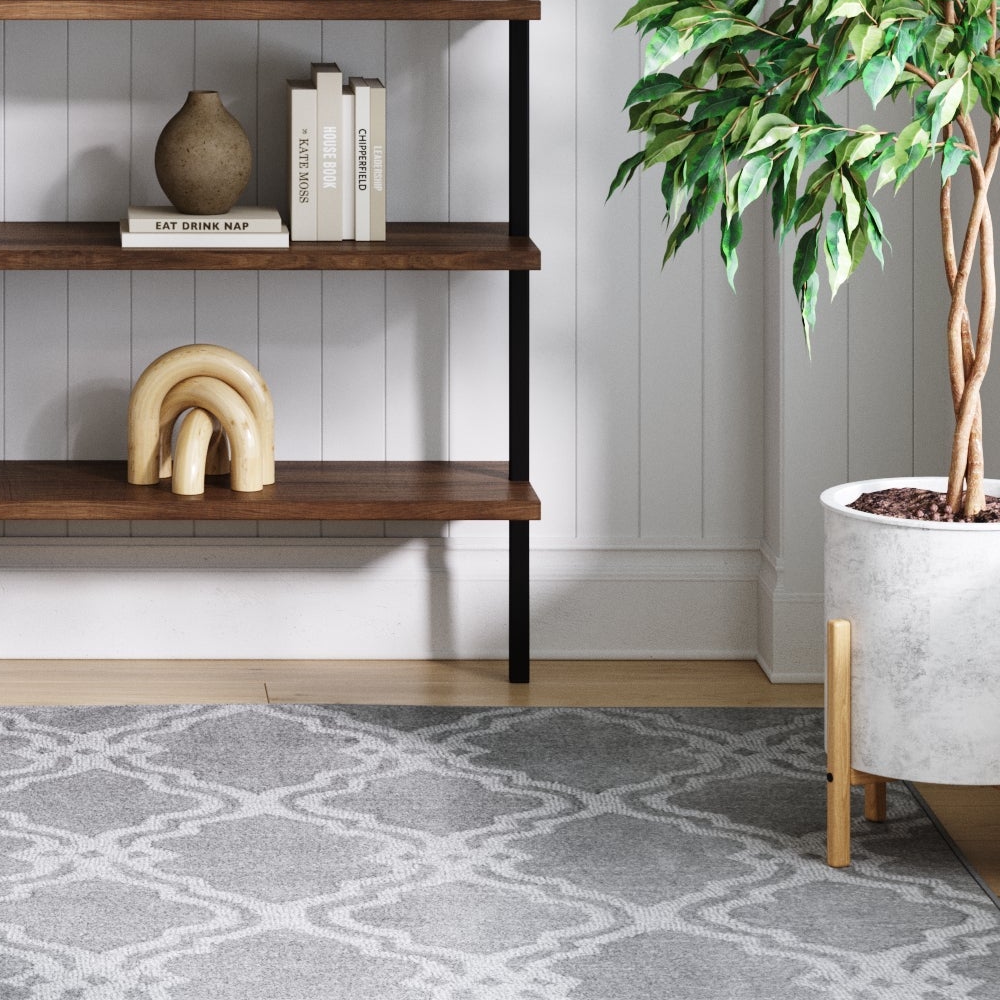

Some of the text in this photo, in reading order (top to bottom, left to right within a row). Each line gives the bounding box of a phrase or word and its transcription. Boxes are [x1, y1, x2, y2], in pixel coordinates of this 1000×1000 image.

[299, 138, 309, 168] KATE
[322, 126, 337, 189] HOUSE BOOK
[358, 128, 367, 191] CHIPPERFIELD
[373, 145, 383, 192] LEADERSHIP
[299, 172, 309, 203] MOSS
[155, 221, 249, 230] EAT DRINK NAP
